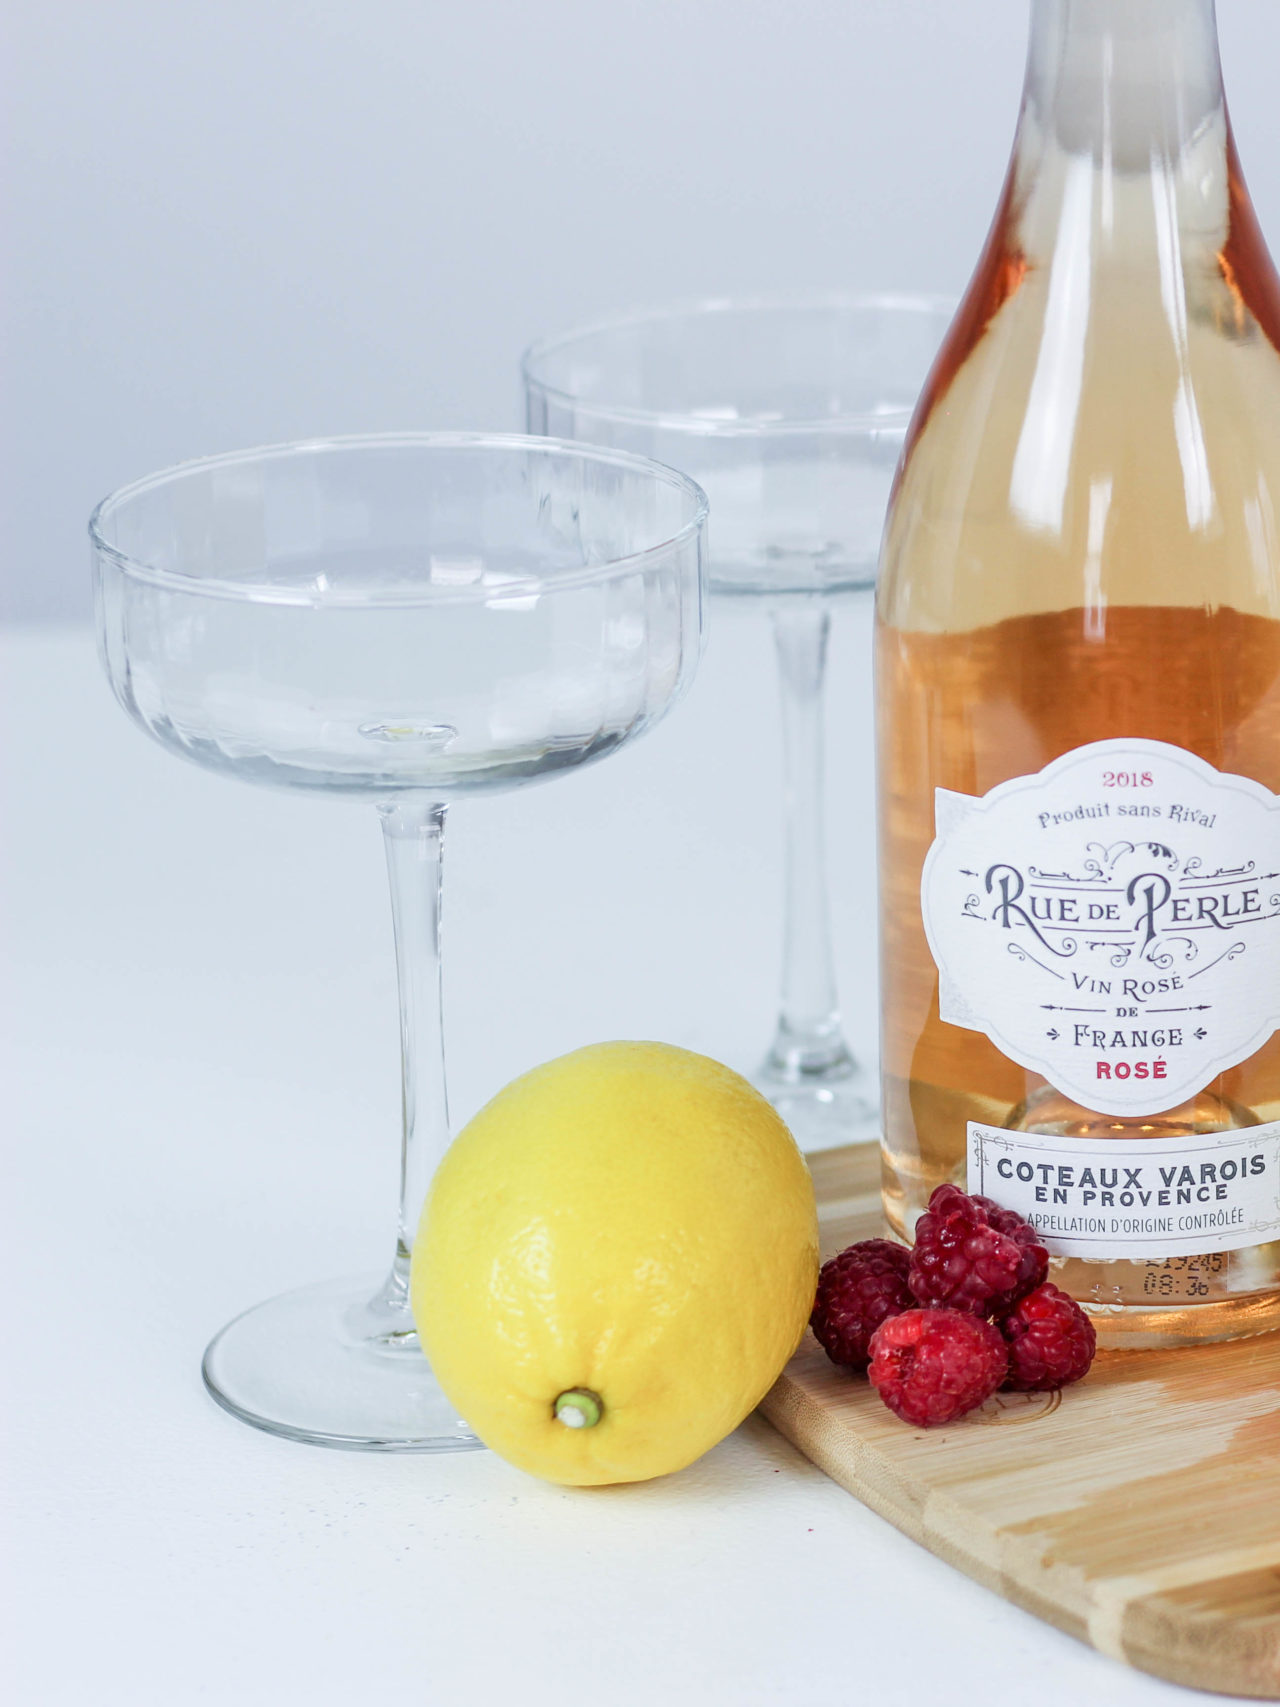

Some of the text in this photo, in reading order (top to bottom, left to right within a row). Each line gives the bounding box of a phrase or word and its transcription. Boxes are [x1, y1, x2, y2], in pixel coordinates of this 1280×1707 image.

[1102, 771, 1154, 788] 2018
[1038, 802, 1217, 829] Produit sans Rival
[985, 864, 1263, 958] RUE DE PERLE
[1071, 970, 1185, 1002] VIN ROSÉ
[1116, 1006, 1139, 1018] DE
[1073, 1024, 1185, 1051] FRANCE
[1096, 1056, 1168, 1079] ROSÉ
[997, 1154, 1266, 1189] COTEAUX VAROIS
[1035, 1183, 1229, 1207] EN PROVENCE
[1027, 1207, 1245, 1233] APPELLATION D'ORIGINE CONTRÔLÉE
